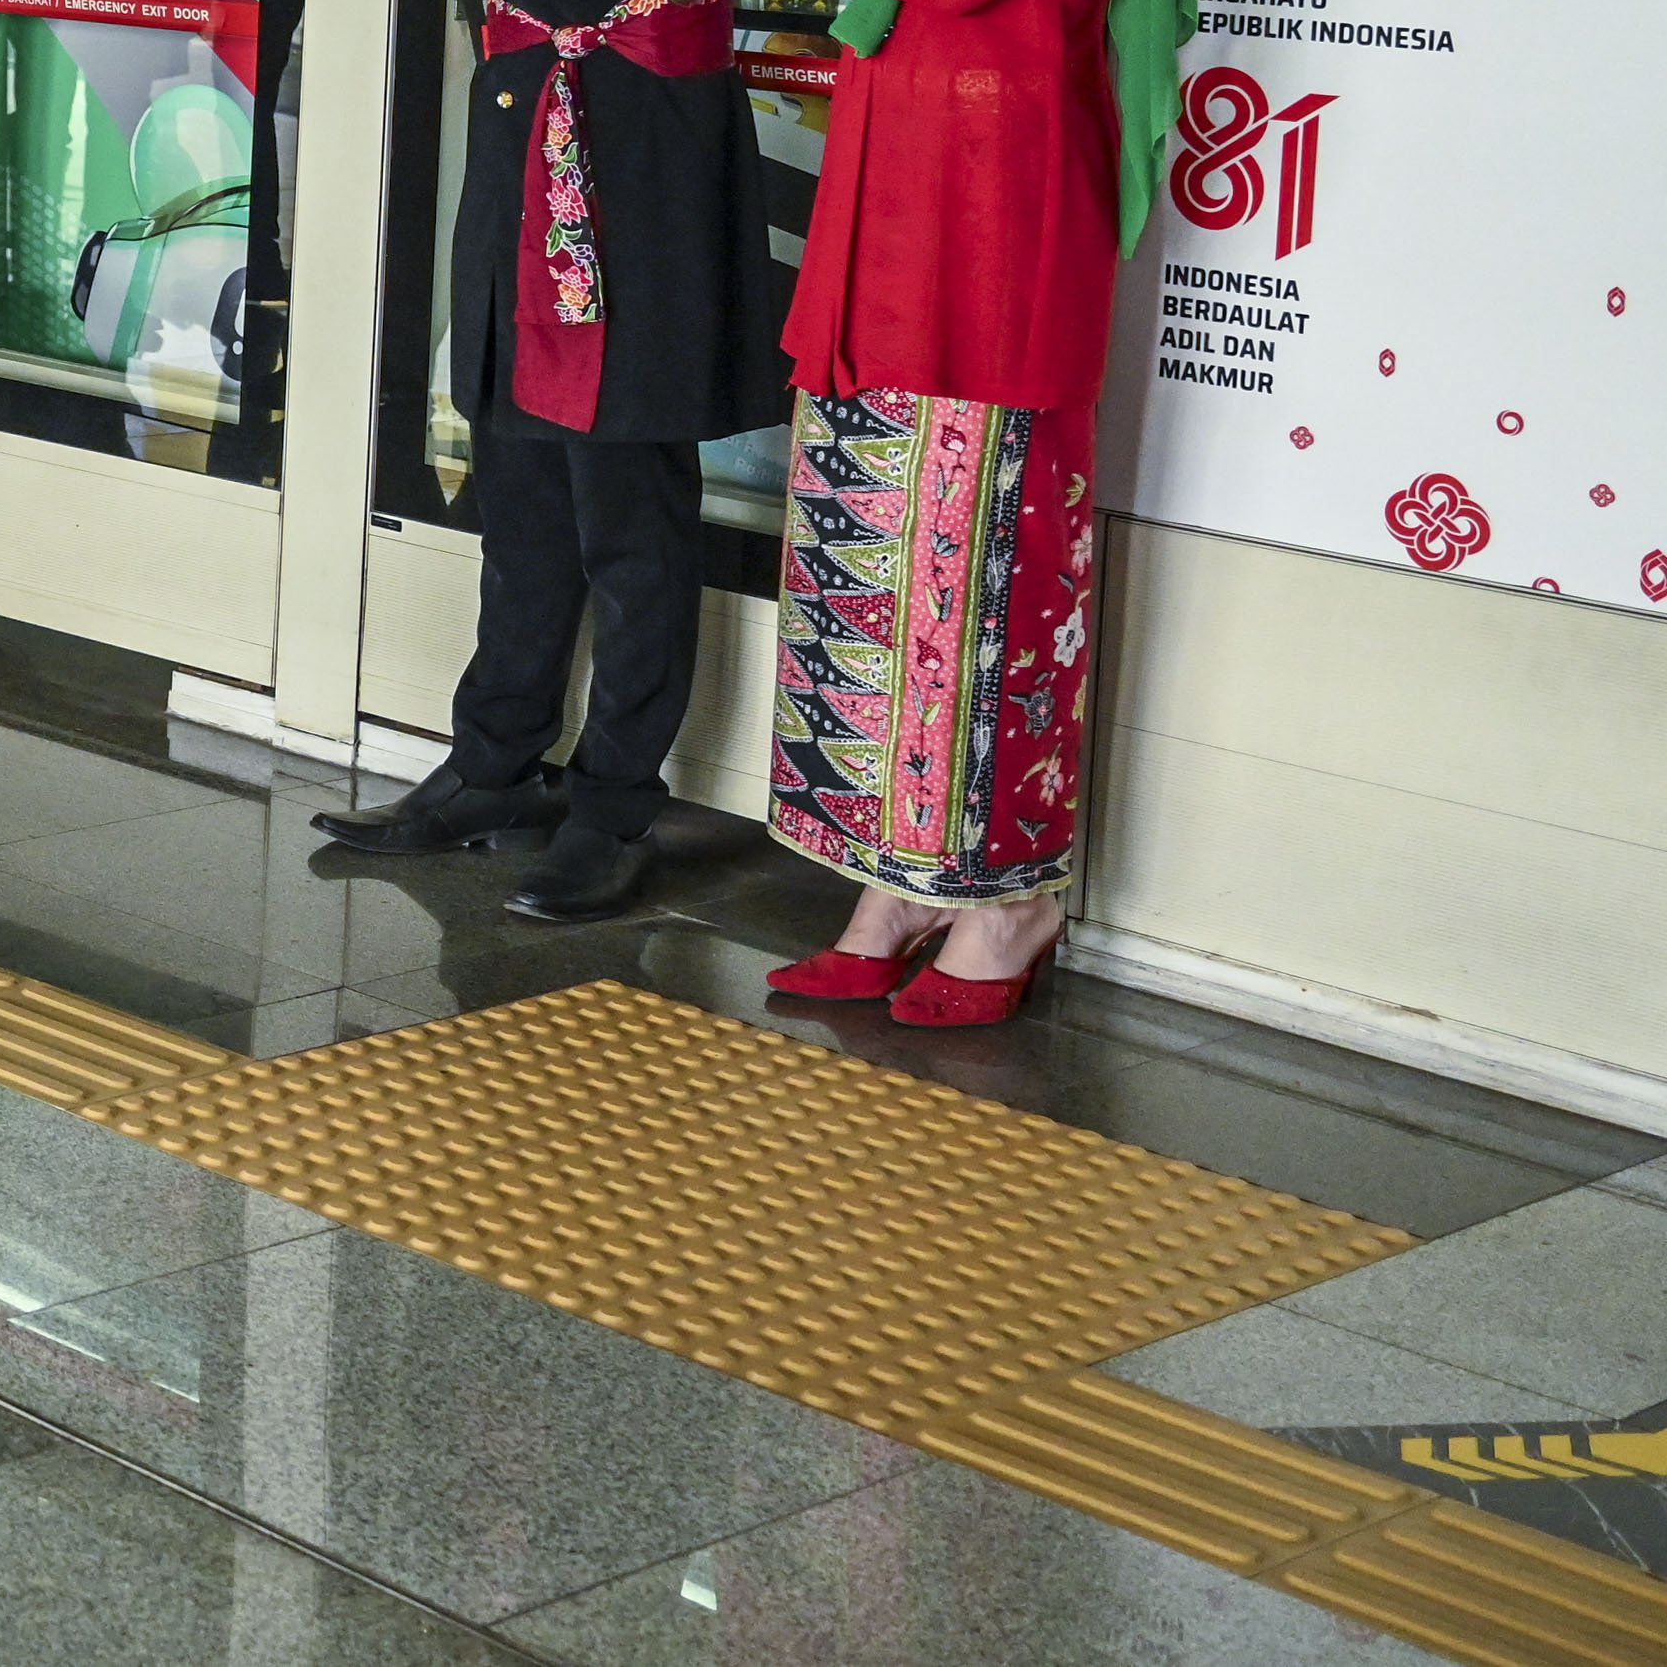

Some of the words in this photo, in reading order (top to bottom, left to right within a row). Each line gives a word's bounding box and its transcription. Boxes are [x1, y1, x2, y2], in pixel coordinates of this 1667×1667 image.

[142, 4, 168, 18] EXIT
[173, 7, 210, 22] DOOR
[1196, 11, 1304, 41] EPUBLIK
[1309, 20, 1455, 53] INDONESIA
[750, 64, 838, 85] EMERGENC
[1170, 66, 1341, 262] 81
[1164, 263, 1301, 302] INDONESIA
[1162, 294, 1311, 335] BERDAULAT
[1159, 326, 1216, 354] ADIL
[1222, 335, 1276, 362] DAN
[1158, 357, 1274, 395] MAKMUR
